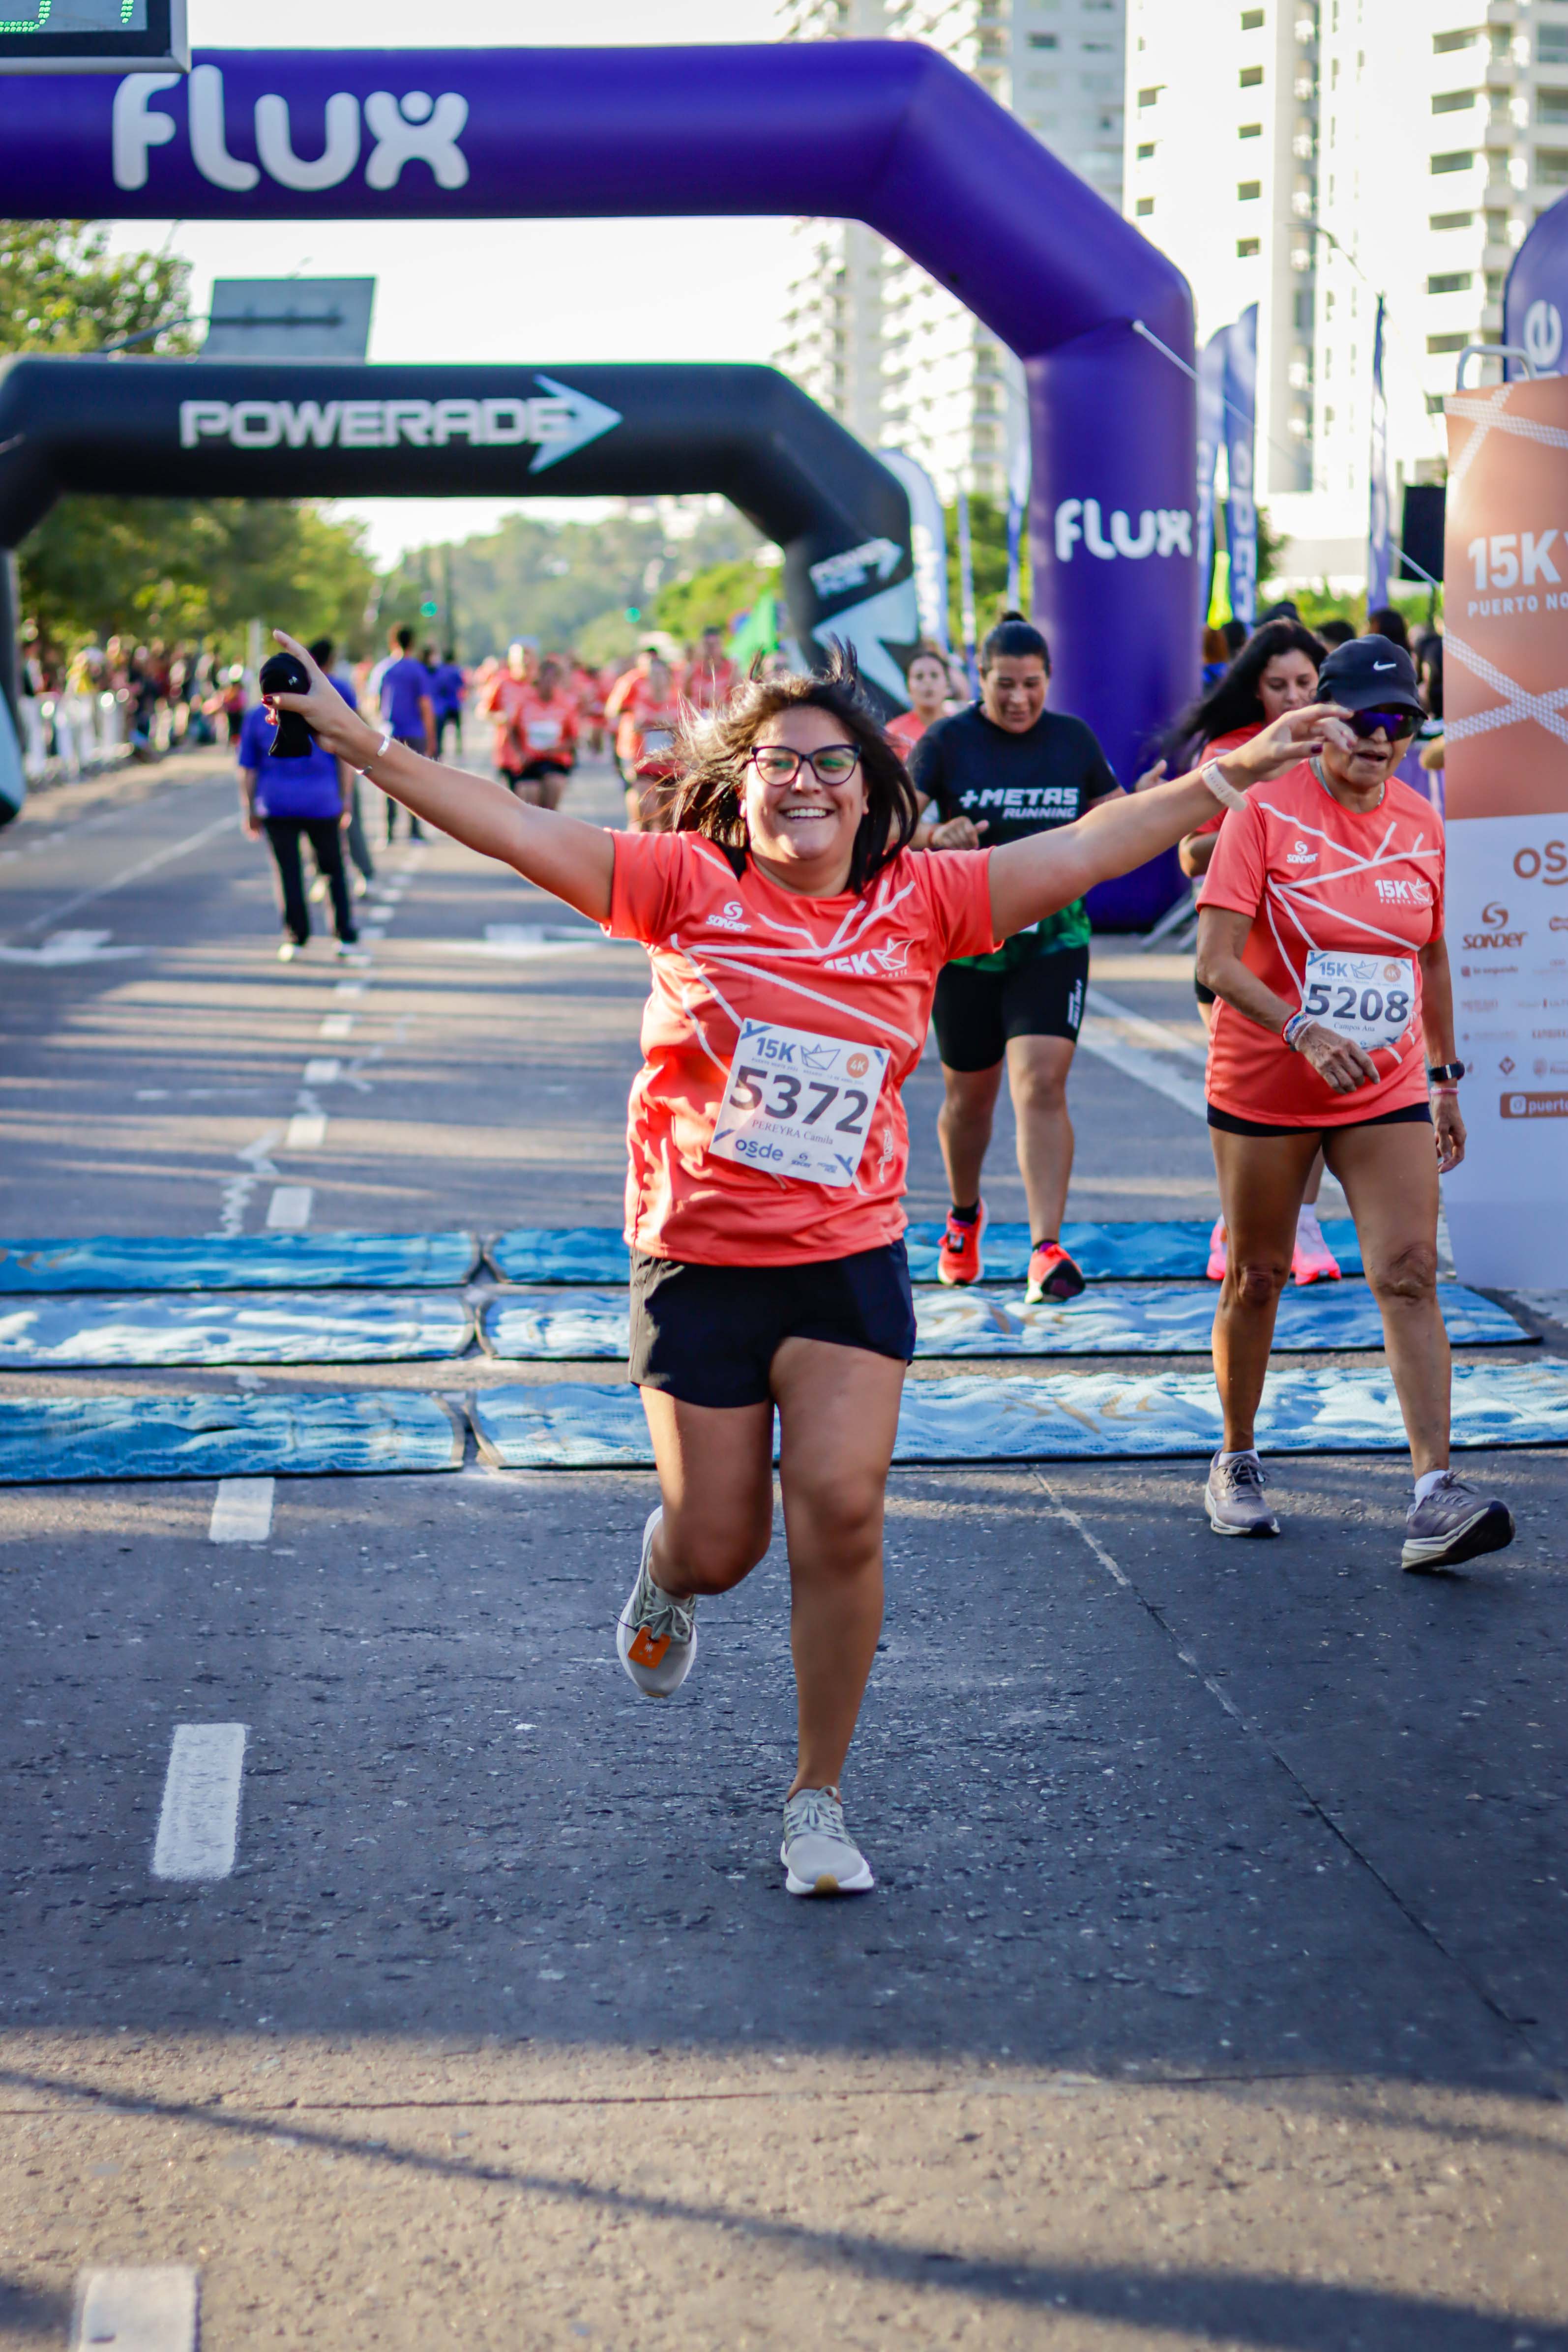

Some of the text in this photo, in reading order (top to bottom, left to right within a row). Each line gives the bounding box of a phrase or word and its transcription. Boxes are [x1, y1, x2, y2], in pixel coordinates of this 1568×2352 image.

[179, 397, 573, 448] POWERADE
[1467, 529, 1562, 590] 15K
[1468, 595, 1539, 618] PUERTO
[1002, 807, 1077, 820] RUNNING
[1375, 879, 1409, 899] 15K
[1319, 961, 1348, 977] 15K
[1386, 968, 1398, 977] 4K
[1305, 983, 1409, 1023] 5208
[1334, 1022, 1375, 1032] Campos Ana
[756, 1036, 797, 1063] 15K
[850, 1059, 866, 1072] 4K
[729, 1065, 869, 1135] 5372
[752, 1119, 833, 1145] PEREYRA Camila
[735, 1139, 784, 1162] osde
